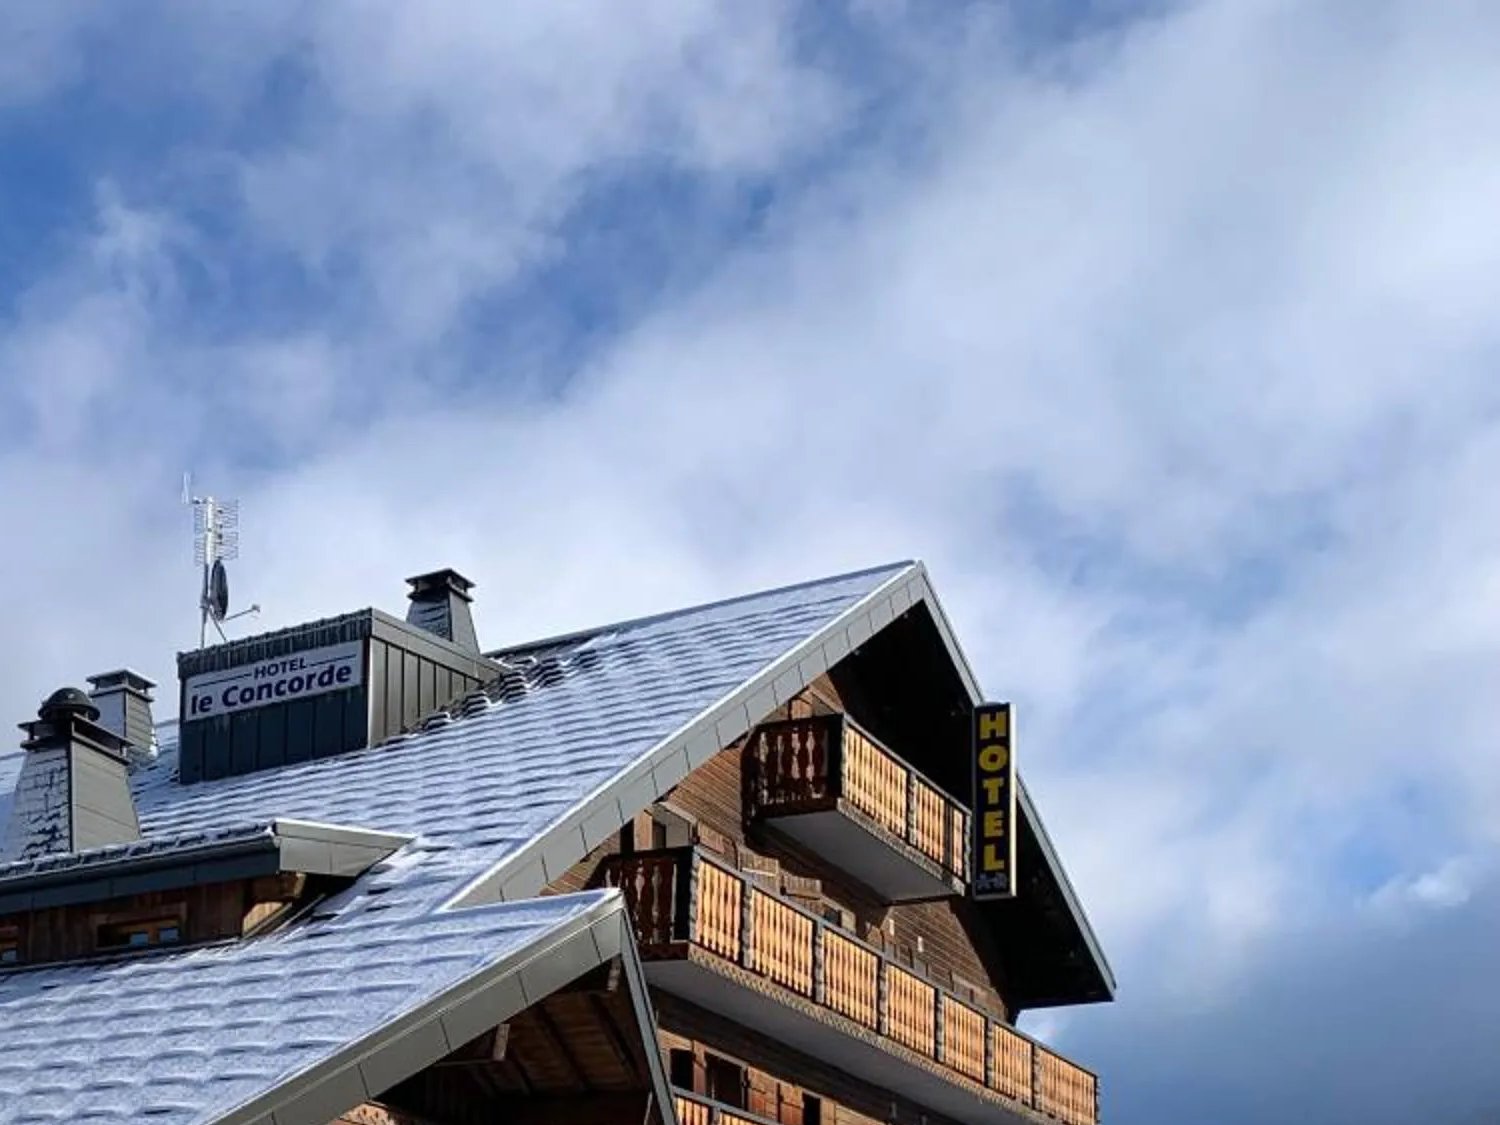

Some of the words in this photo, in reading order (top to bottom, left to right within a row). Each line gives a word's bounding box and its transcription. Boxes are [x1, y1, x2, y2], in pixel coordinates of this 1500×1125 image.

[191, 695, 213, 715] le
[222, 664, 352, 707] Concorde
[254, 658, 307, 680] HOTEL
[978, 711, 1008, 871] HOTEL
